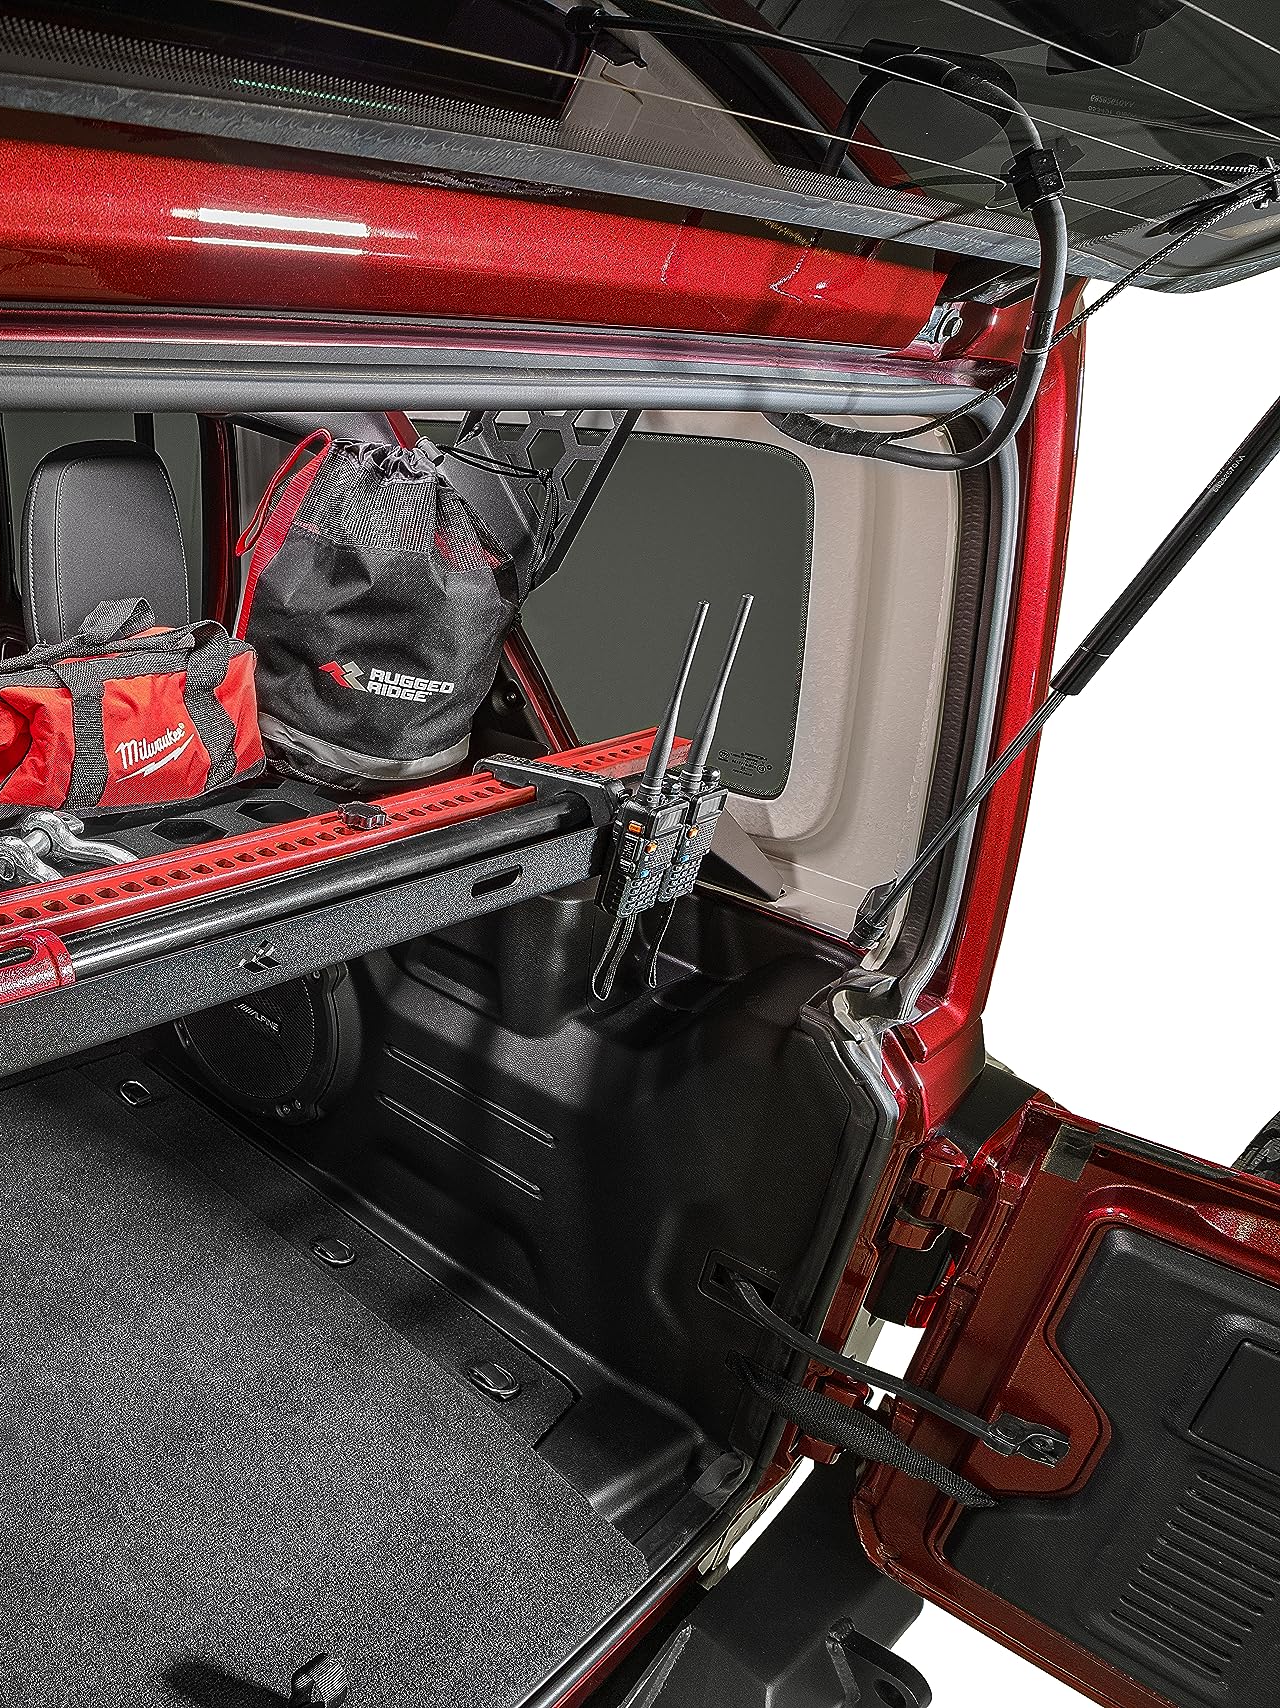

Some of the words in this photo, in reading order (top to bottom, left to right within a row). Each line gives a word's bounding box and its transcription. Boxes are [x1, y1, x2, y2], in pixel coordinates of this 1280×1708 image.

[366, 680, 427, 703] RIDGE
[369, 667, 455, 694] RUGGED
[114, 727, 186, 770] Milwaukee
